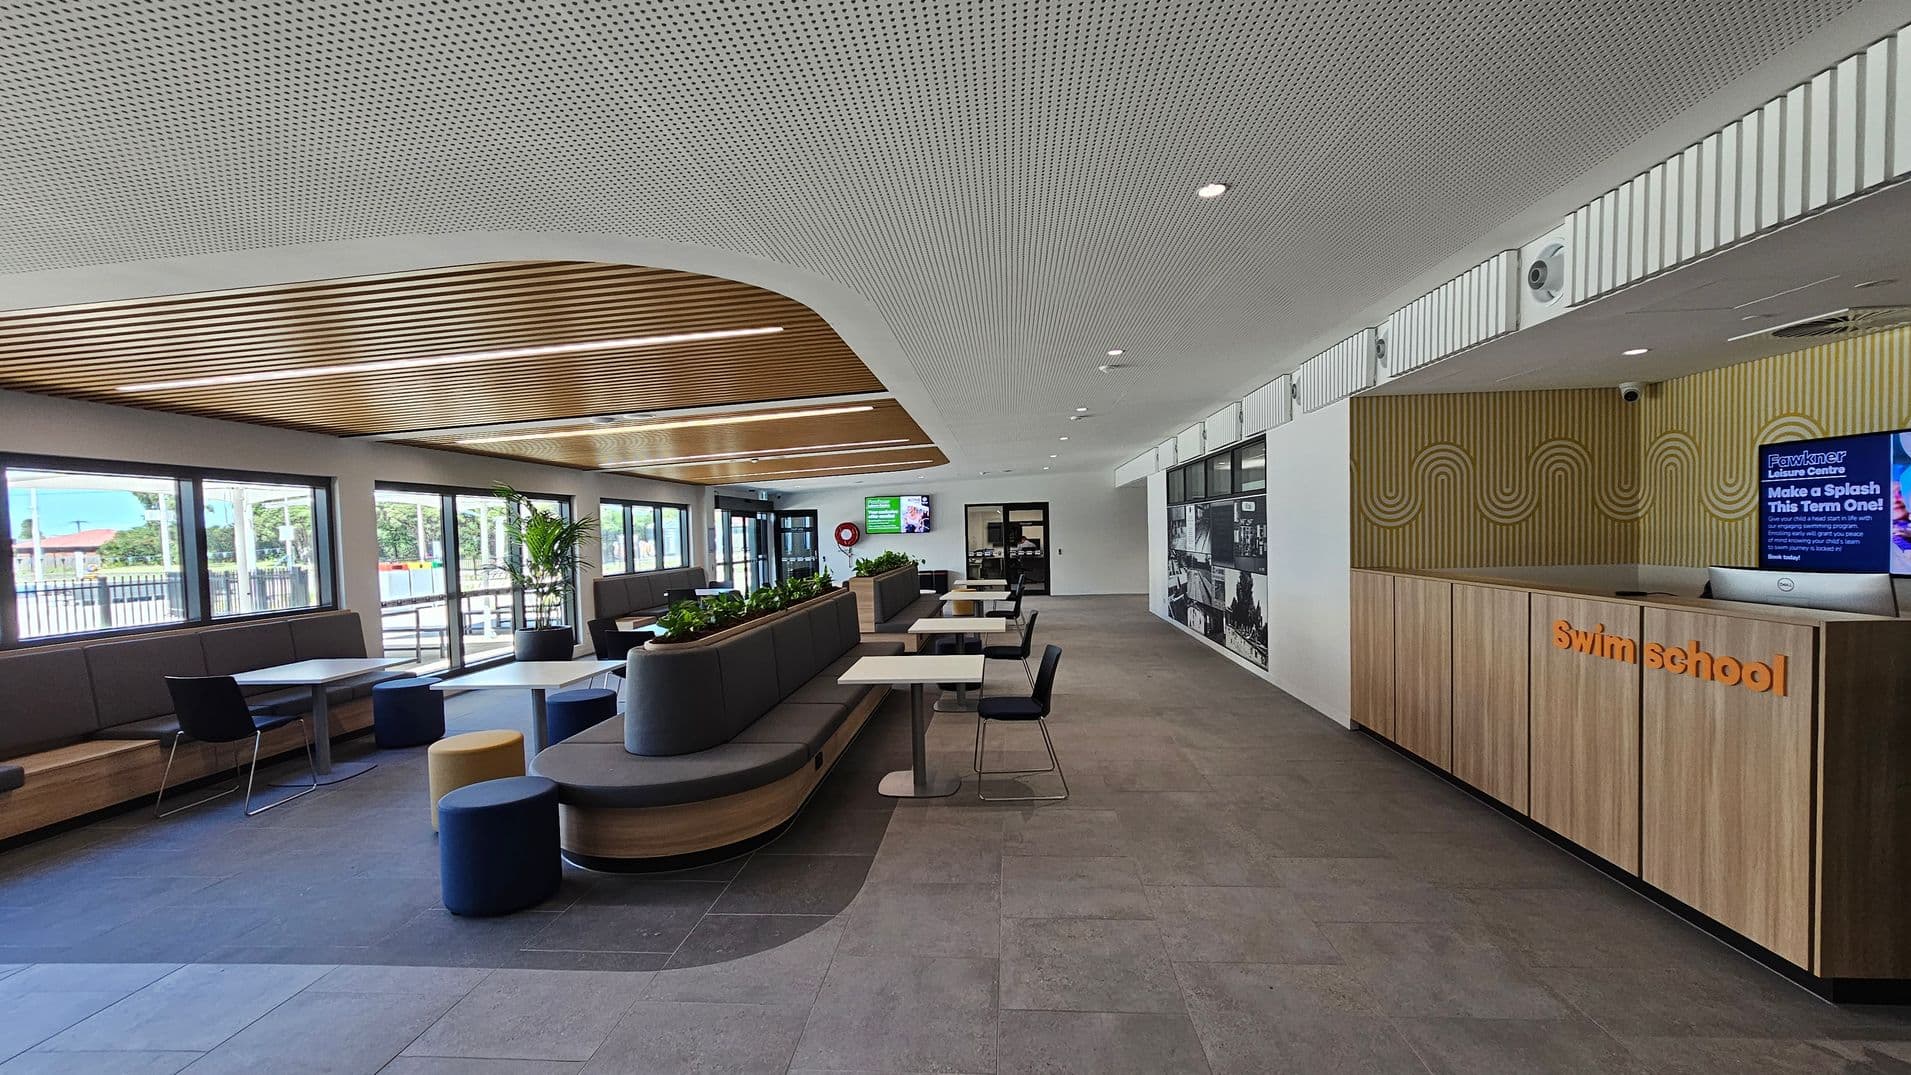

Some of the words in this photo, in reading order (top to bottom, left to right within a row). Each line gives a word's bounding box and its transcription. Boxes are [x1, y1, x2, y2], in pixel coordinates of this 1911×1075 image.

[1768, 450, 1847, 468] Fawkner
[1768, 468, 1806, 478] Leisure
[1807, 465, 1846, 476] Centre
[1768, 485, 1808, 498] Make
[1810, 487, 1821, 497] a
[1824, 481, 1881, 498] Splash
[1768, 500, 1799, 513] This
[1800, 500, 1841, 512] Term
[1844, 498, 1884, 512] One!
[1552, 618, 1637, 665] Swim
[1643, 640, 1789, 697] school
